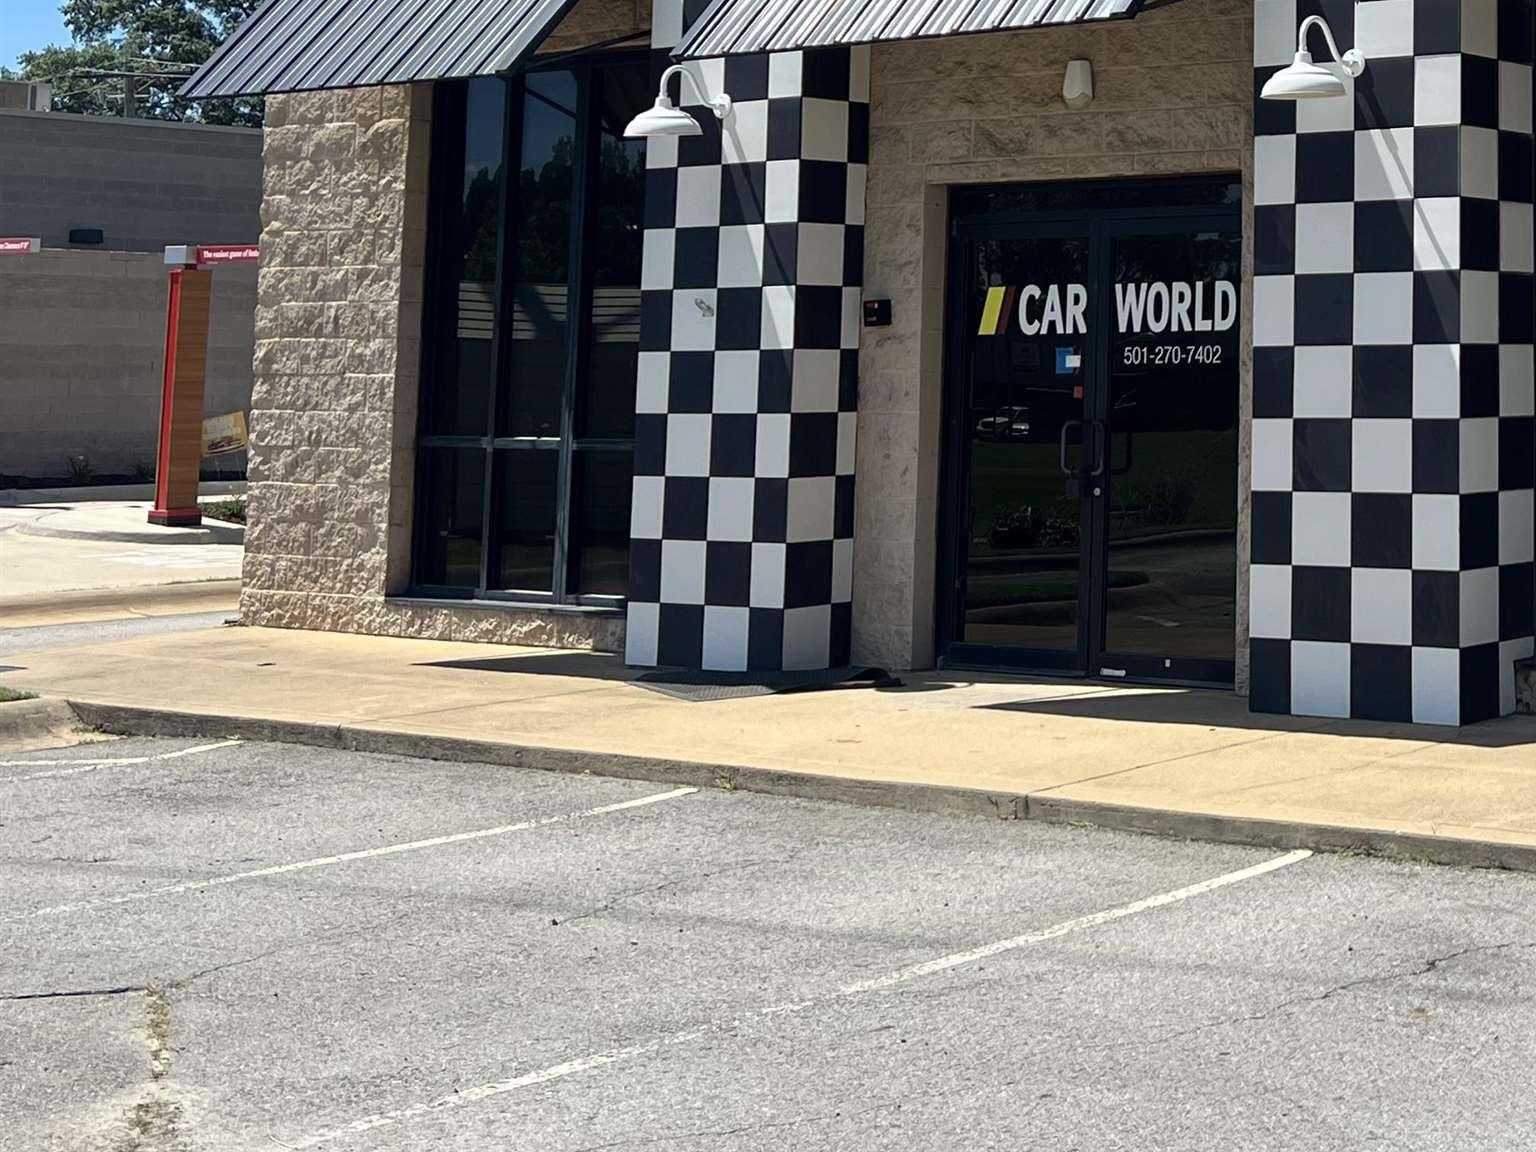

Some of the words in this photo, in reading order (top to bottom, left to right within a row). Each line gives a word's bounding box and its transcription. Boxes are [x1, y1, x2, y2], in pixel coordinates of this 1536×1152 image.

[203, 250, 213, 258] The
[1018, 284, 1088, 336] CAR
[1114, 280, 1237, 333] WORLD
[1123, 345, 1222, 365] 501-270-7402
